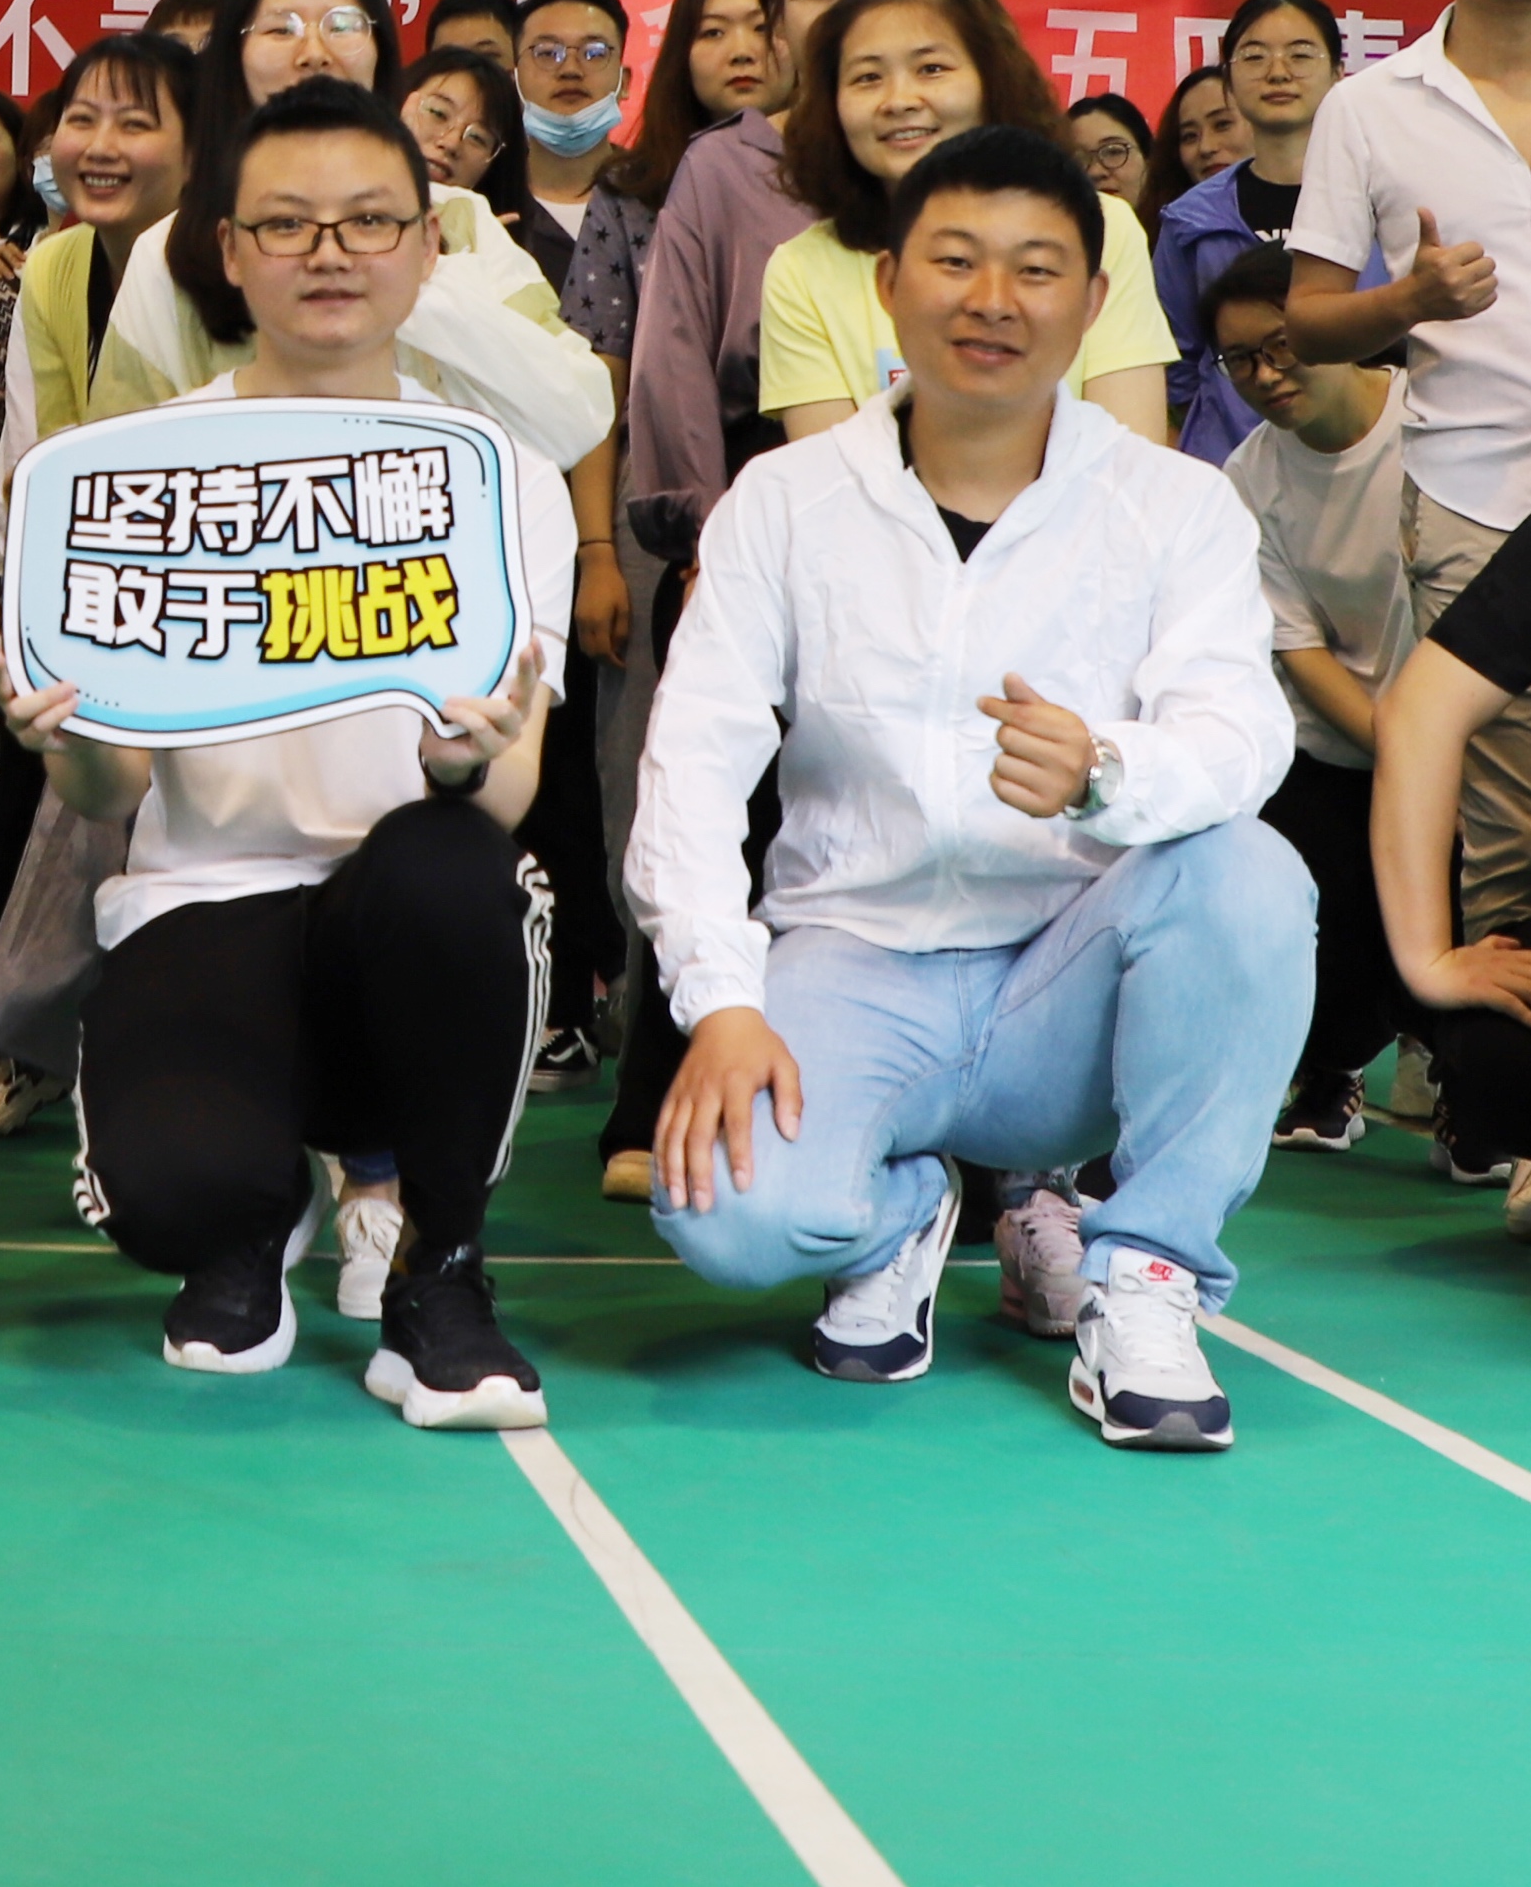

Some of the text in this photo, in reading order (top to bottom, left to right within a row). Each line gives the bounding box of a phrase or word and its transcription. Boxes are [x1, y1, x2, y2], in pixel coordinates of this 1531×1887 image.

[69, 447, 453, 554] 坚持不懈
[63, 555, 457, 662] 敢于挑战
